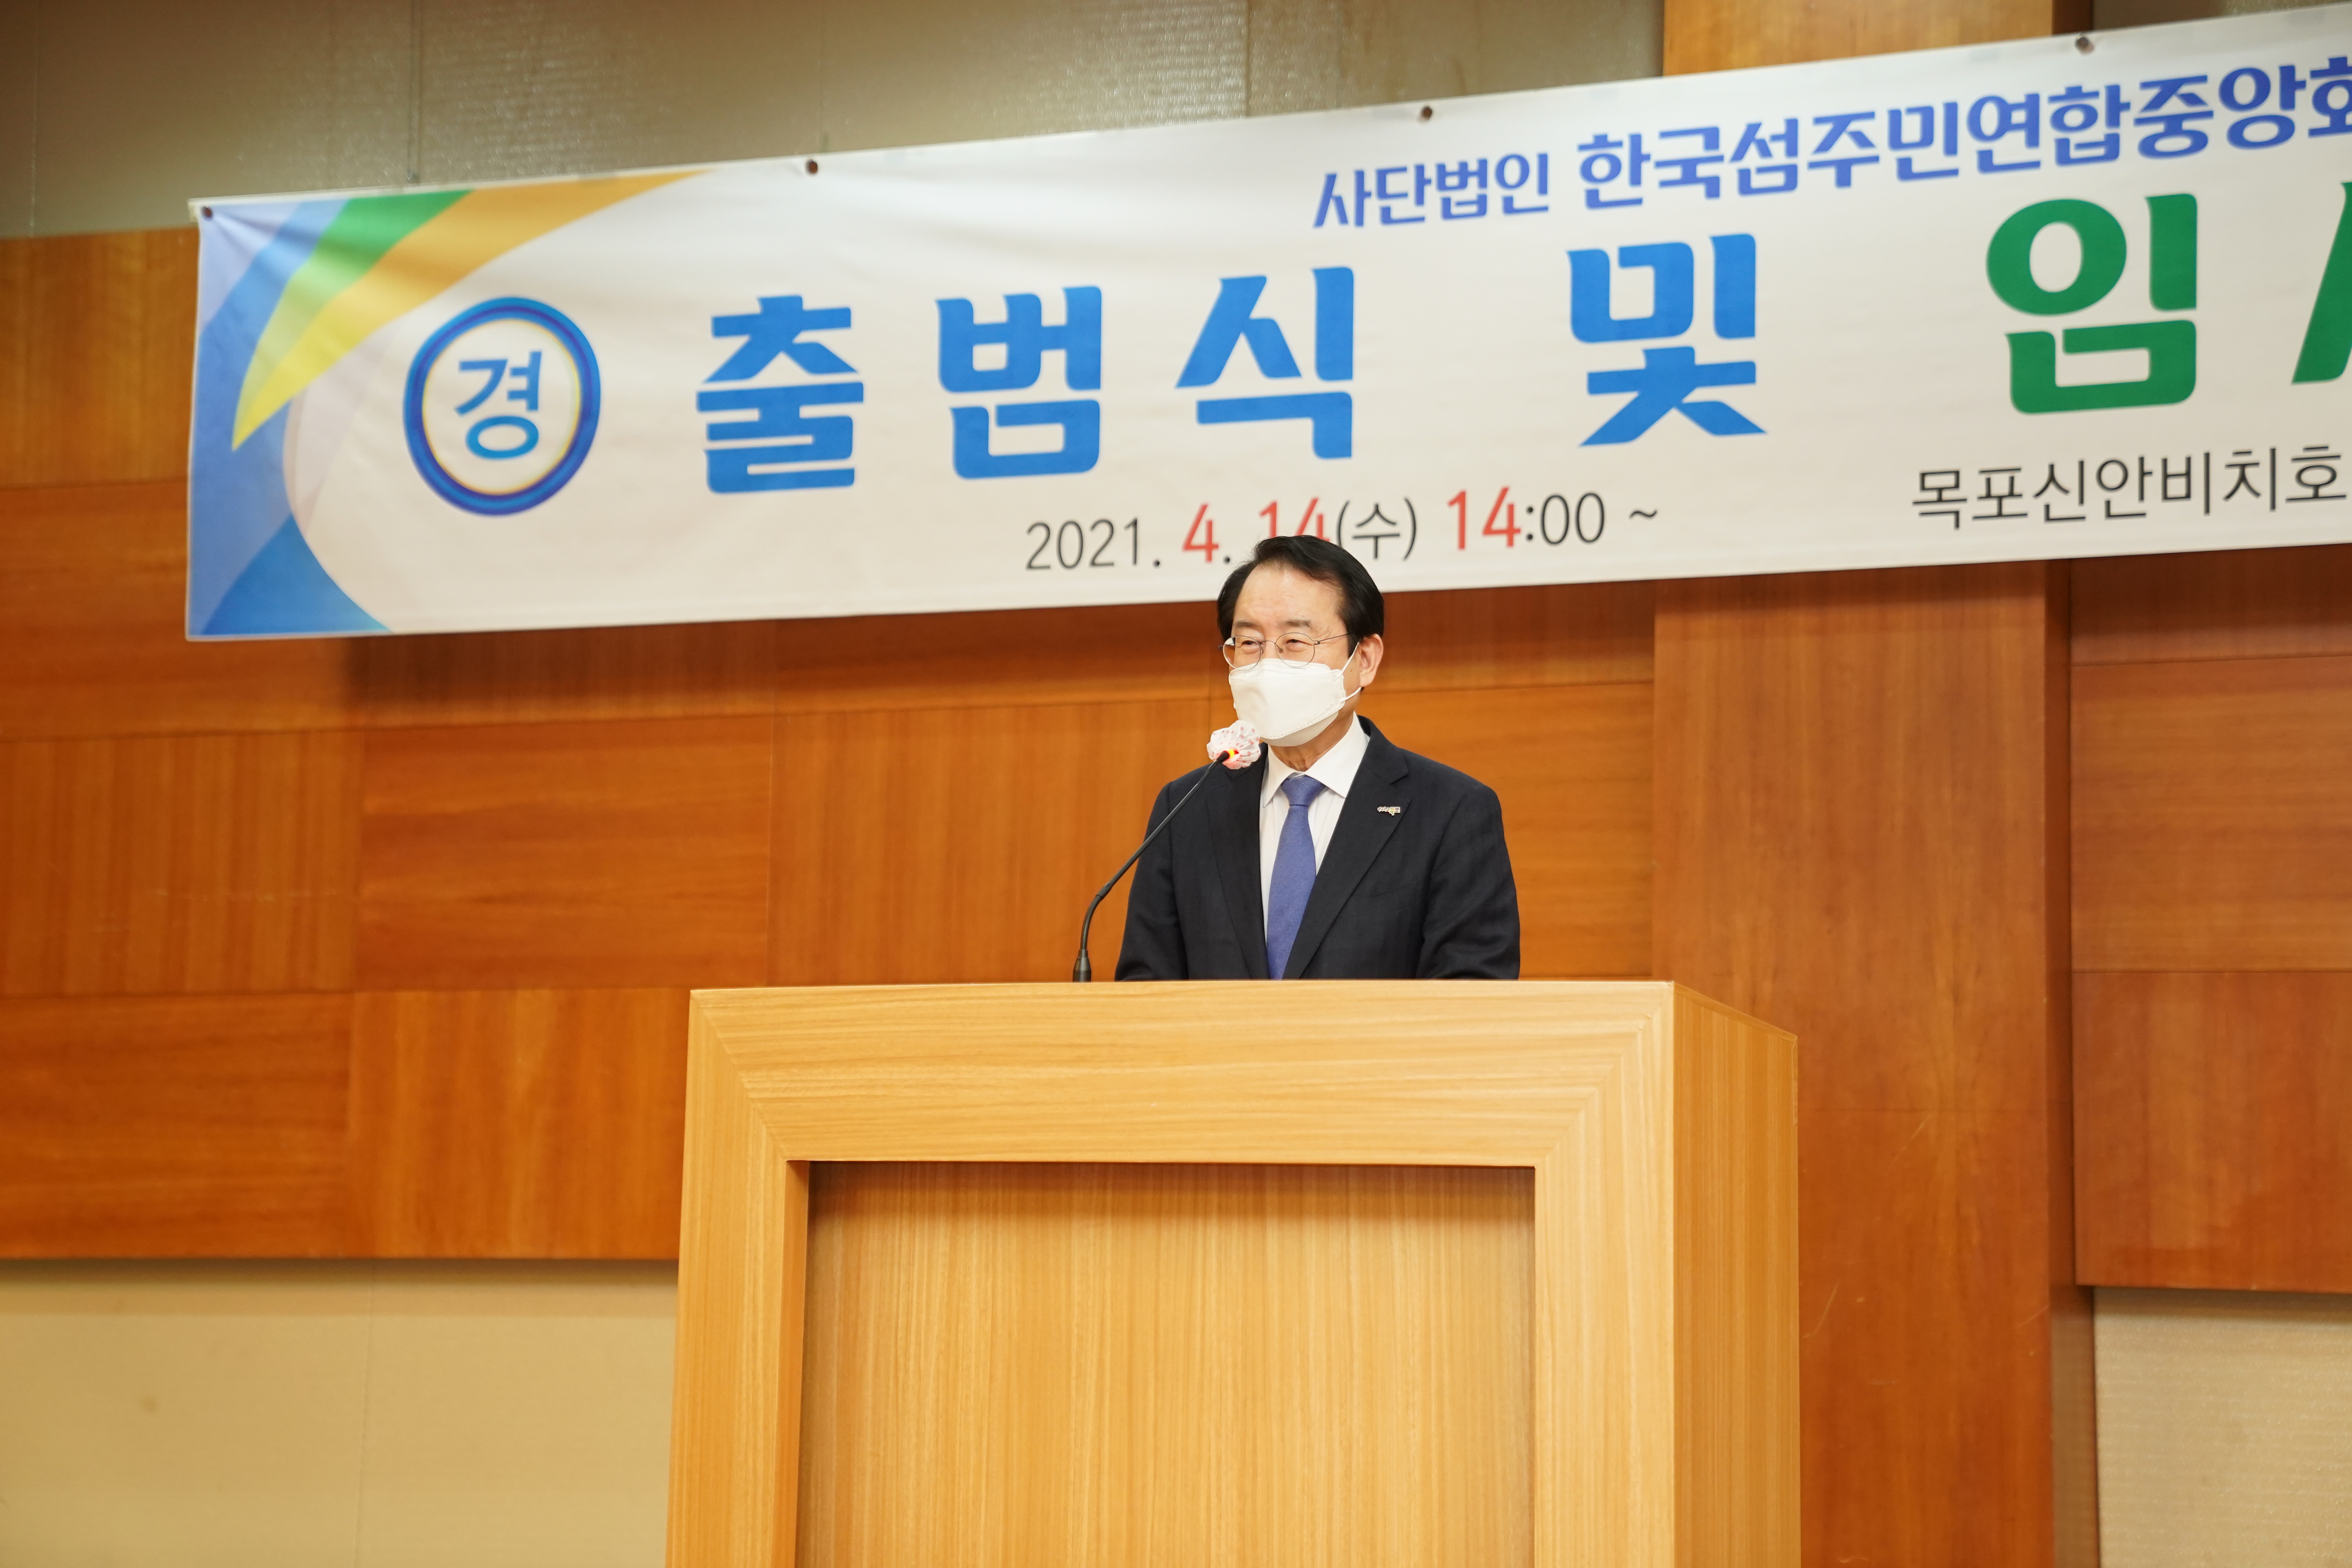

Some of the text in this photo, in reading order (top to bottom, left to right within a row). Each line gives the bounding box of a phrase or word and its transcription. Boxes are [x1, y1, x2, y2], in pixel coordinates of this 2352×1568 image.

[1313, 152, 1550, 228] 사단법인
[454, 351, 543, 460] 경
[696, 266, 1356, 494] 출범식
[1566, 233, 1767, 447] 및
[1026, 517, 1161, 570] 2021.
[1182, 503, 1230, 564] 4.
[1447, 486, 1606, 551] 14:00
[1912, 445, 2347, 530] 목포신안비치호
